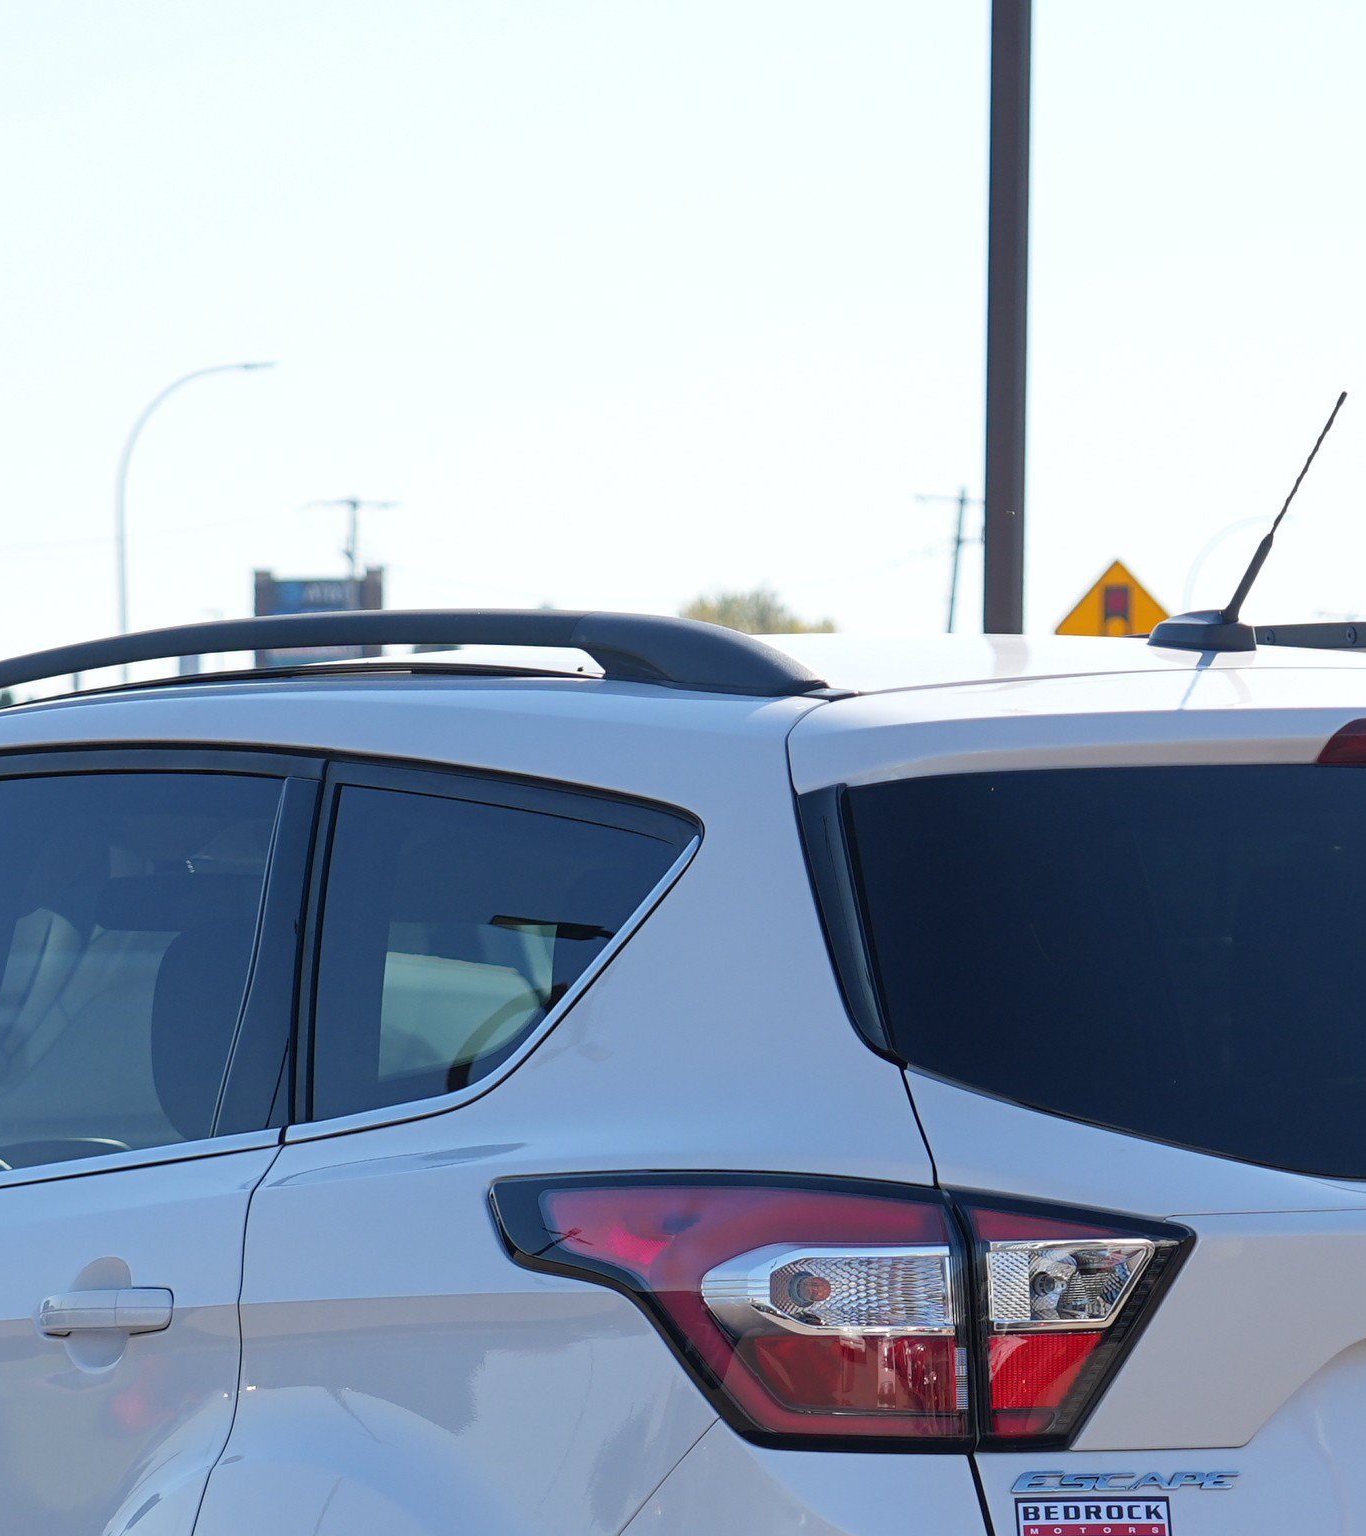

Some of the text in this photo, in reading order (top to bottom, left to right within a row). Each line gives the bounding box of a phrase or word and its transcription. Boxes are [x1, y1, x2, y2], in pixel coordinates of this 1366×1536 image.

[1011, 1470, 1240, 1493] ESCAPE
[1022, 1504, 1165, 1521] BEDROCK
[1029, 1526, 1160, 1535] MOTORS
